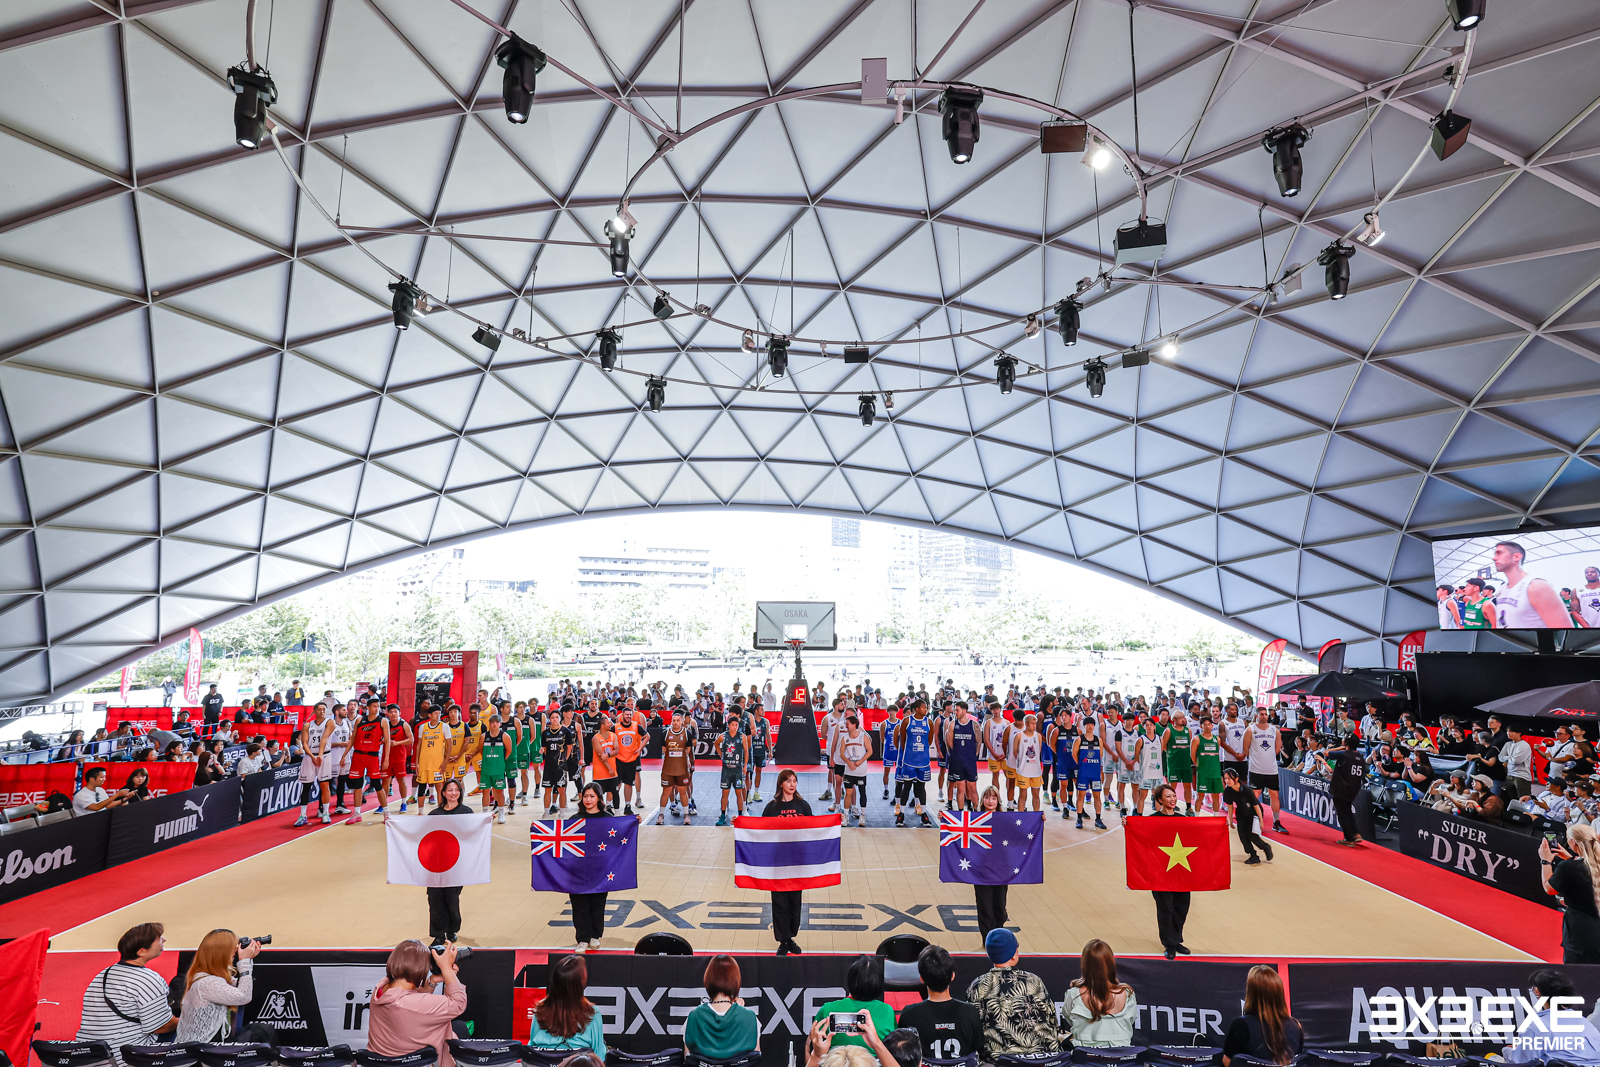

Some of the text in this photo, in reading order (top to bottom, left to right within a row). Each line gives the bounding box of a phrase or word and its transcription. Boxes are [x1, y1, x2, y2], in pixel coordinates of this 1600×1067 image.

[784, 609, 808, 618] OSAKA
[795, 688, 805, 700] 12
[1351, 764, 1362, 776] 65
[258, 775, 319, 816] PLAYOS
[1442, 820, 1488, 845] SUPER
[1054, 1001, 1226, 1036] PTNER
[249, 1020, 308, 1030] INAGA
